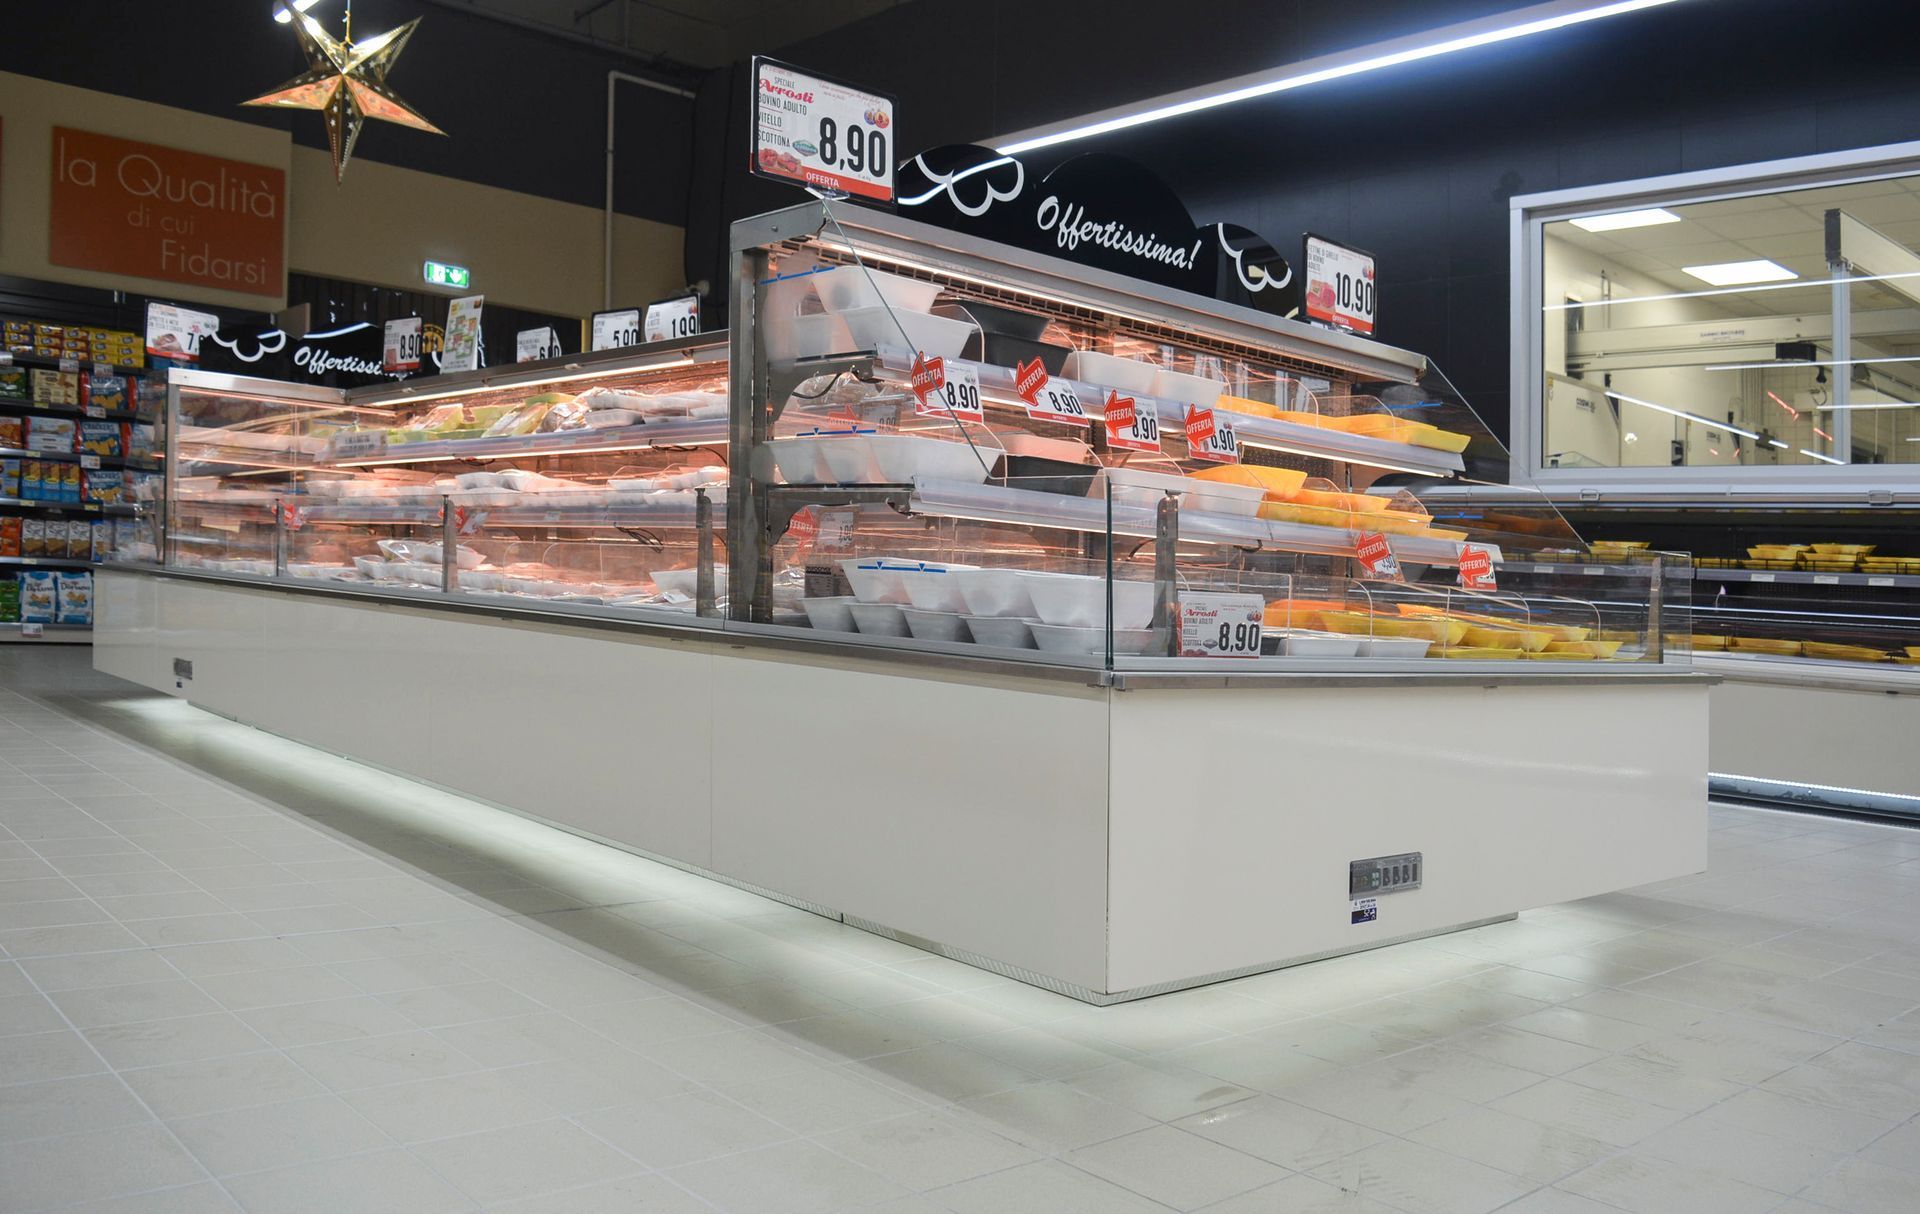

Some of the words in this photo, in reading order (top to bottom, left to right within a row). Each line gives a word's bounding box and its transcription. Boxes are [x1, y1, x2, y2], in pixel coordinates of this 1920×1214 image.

[759, 78, 814, 104] Arrosti
[783, 99, 807, 116] ADULTO
[758, 129, 791, 147] SCOTTONA
[819, 116, 886, 178] 8,90
[60, 136, 96, 187] la
[118, 154, 276, 219] Qualità
[806, 171, 840, 188] OFFERTA
[127, 202, 150, 228] di
[160, 215, 195, 235] cui
[1036, 195, 1202, 270] Offertissima!
[161, 238, 267, 285] Fidarsi
[1336, 271, 1373, 315] 10,90
[400, 334, 421, 360] 8,90
[912, 366, 943, 387] OFFERTA
[1017, 366, 1044, 395] OFFERTA
[946, 381, 979, 410] 8,90
[1048, 391, 1083, 415] 8,90
[1105, 407, 1133, 422] OFFERTA
[1186, 418, 1213, 435] OFFERTA
[1132, 416, 1158, 441] 8,90
[1357, 541, 1385, 558] OFFERTA
[1459, 559, 1487, 571] OFFERTA
[1184, 608, 1218, 618] Arrosti
[1219, 622, 1260, 652] 8,90
